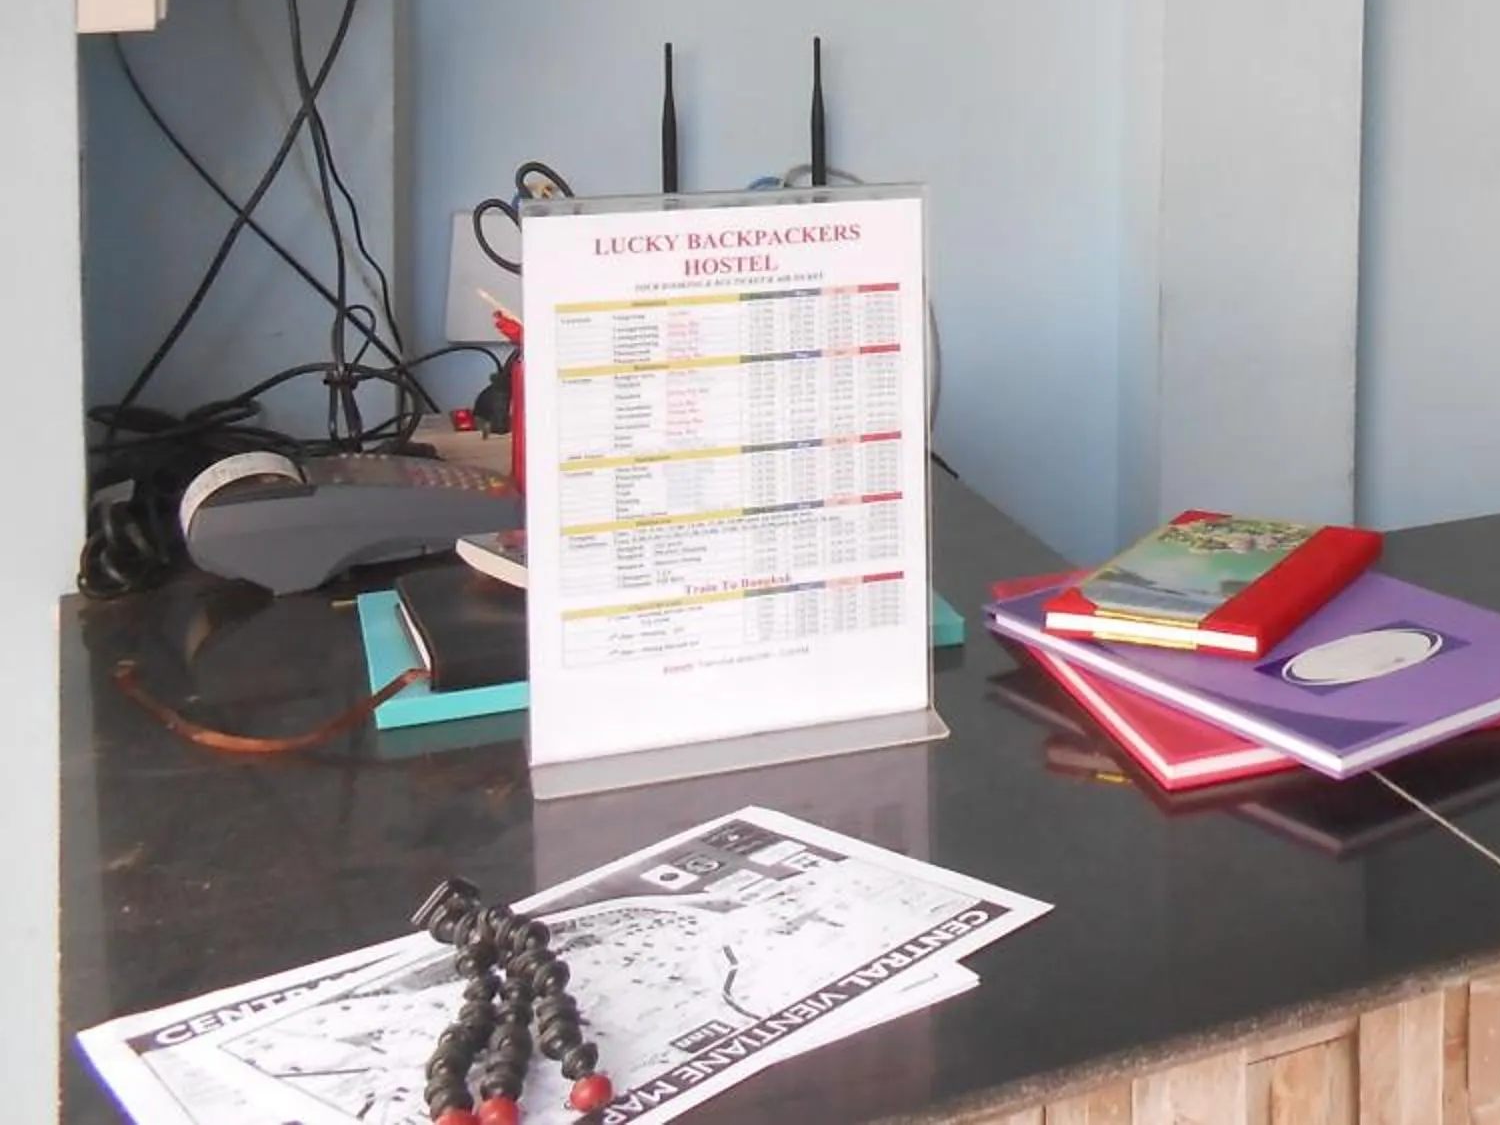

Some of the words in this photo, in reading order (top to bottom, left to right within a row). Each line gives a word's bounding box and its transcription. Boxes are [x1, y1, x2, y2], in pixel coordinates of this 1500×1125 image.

[593, 233, 679, 256] LUCKY
[687, 223, 862, 250] BACKPACKERS
[683, 254, 779, 277] HOSTEL
[838, 910, 989, 989] CENTRAL
[672, 991, 848, 1085] VIENTIANE
[602, 1079, 679, 1124] MAP
